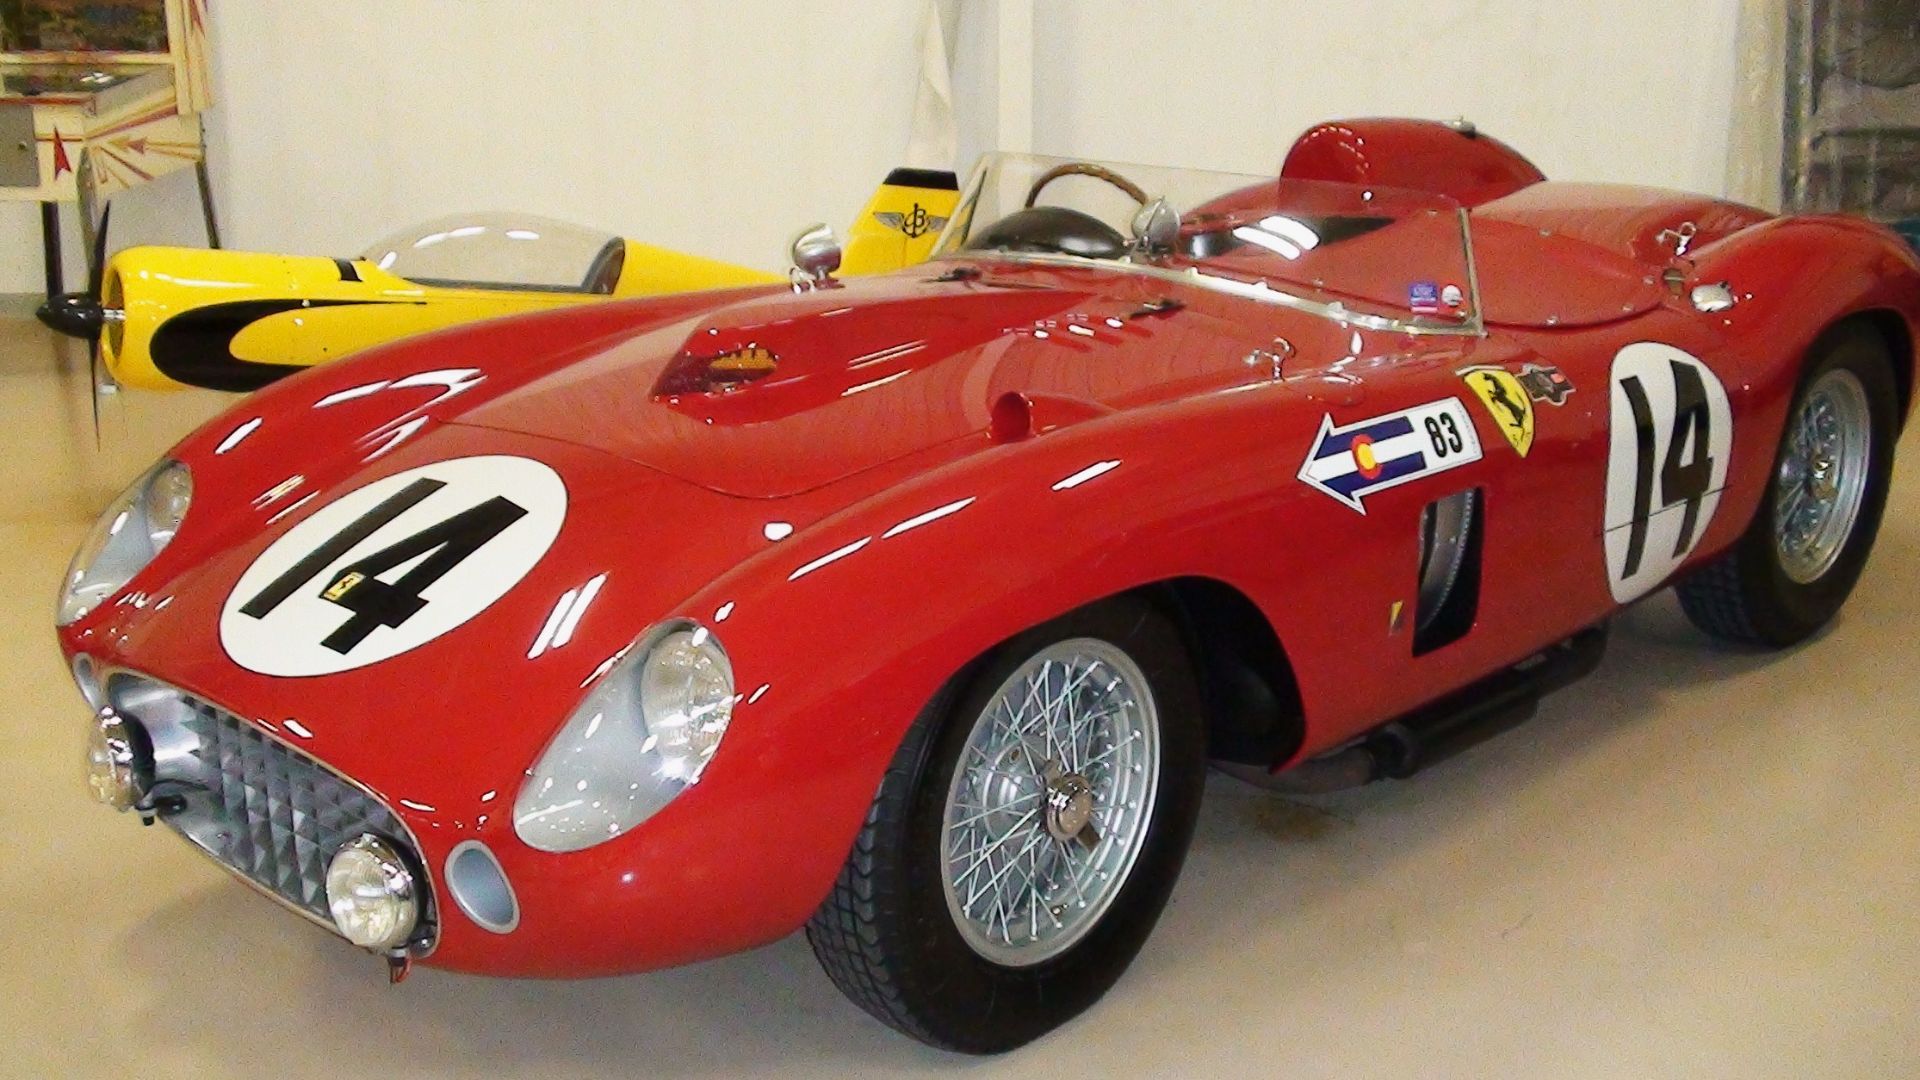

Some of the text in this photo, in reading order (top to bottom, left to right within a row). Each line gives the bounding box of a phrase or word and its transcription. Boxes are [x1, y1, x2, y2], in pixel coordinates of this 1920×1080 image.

[1424, 412, 1463, 458] 83
[1619, 359, 1714, 581] 14
[238, 477, 530, 656] 14
